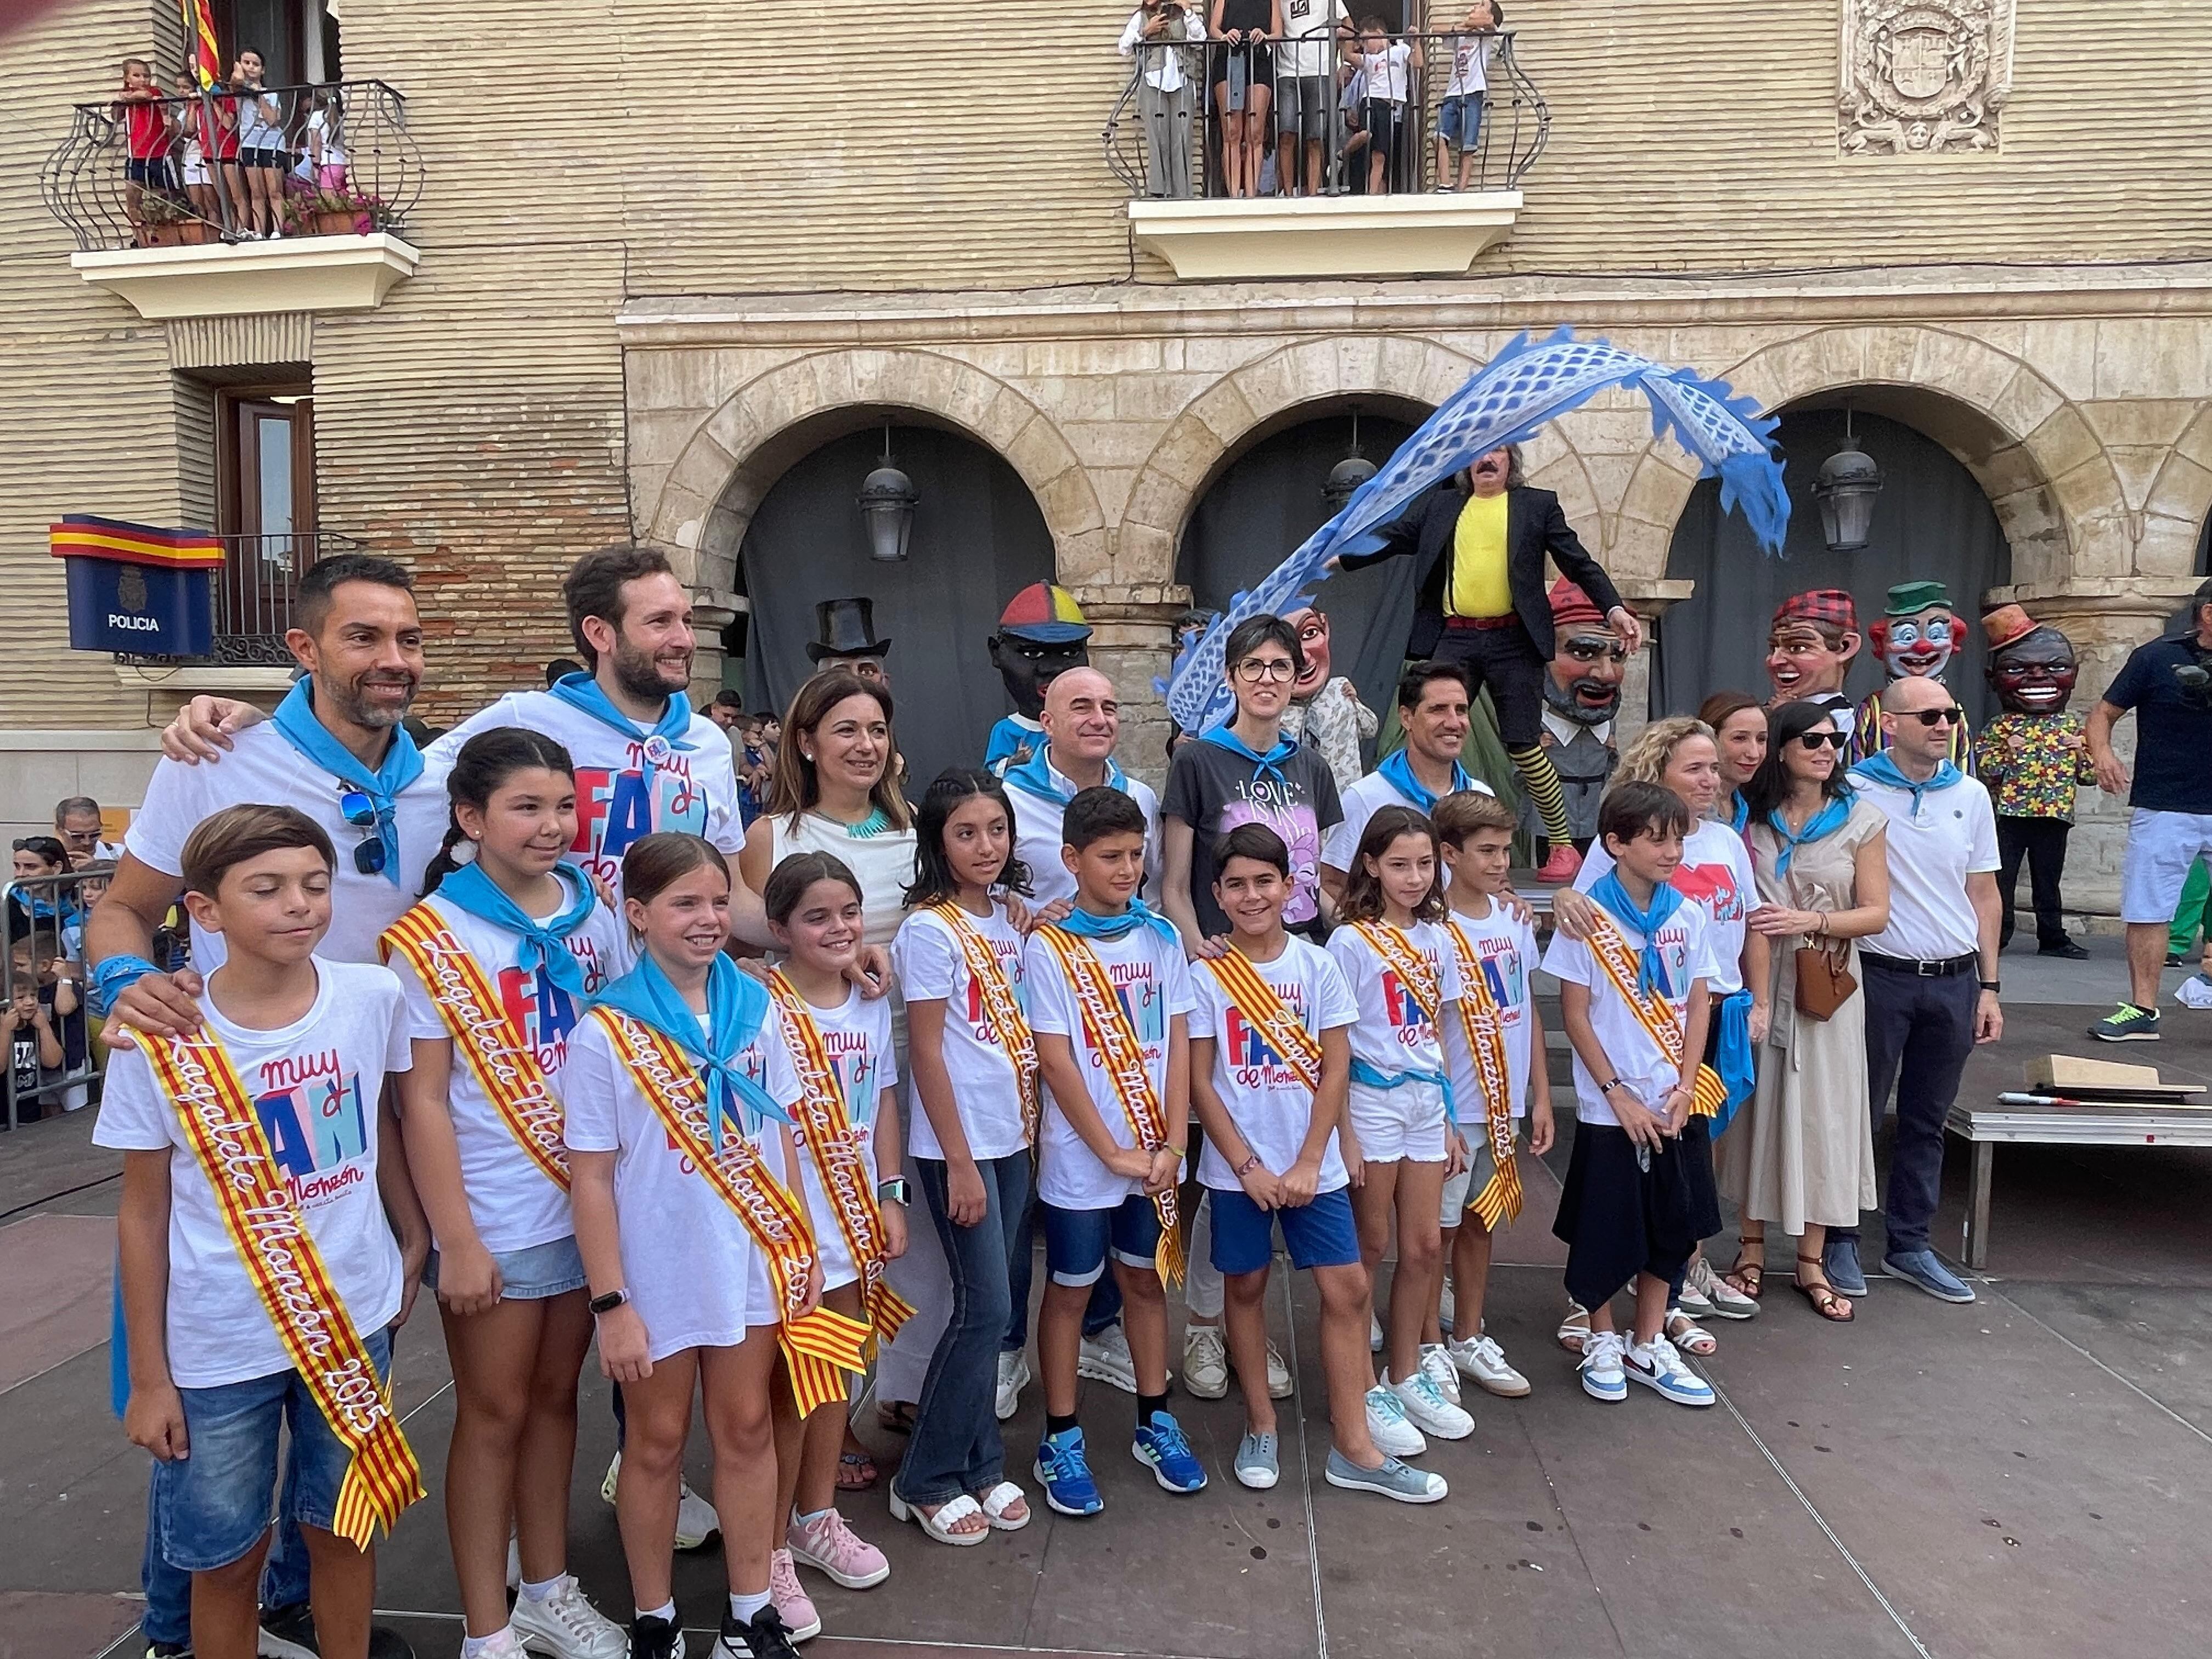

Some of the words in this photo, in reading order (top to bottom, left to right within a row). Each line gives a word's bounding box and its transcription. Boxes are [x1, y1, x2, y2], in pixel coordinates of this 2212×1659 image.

[109, 614, 159, 631] POLICIA
[1239, 780, 1298, 806] LOVE
[1249, 799, 1269, 822] IS
[1273, 804, 1298, 827] IN
[1479, 936, 1518, 975] muy
[1480, 952, 1523, 1009] AN
[420, 930, 535, 1086] Zagaleta
[1109, 962, 1156, 1008] muy
[975, 1007, 1000, 1045] de
[1398, 1014, 1418, 1047] de
[260, 1048, 351, 1118] muy
[822, 1031, 871, 1084] muy
[1237, 1051, 1261, 1088] de
[1470, 1006, 1503, 1107] Monzón
[1494, 1112, 1515, 1159] 2025
[1063, 945, 1127, 1060] Zagalete
[1159, 1188, 1178, 1227] 025
[253, 1070, 368, 1177] AN
[285, 1164, 364, 1205] Monzón
[822, 1129, 870, 1250] Monzón
[166, 1024, 266, 1194] Zagalete
[244, 1189, 330, 1358] Monzón
[325, 1358, 393, 1434] 2025
[708, 1133, 792, 1245] Monzón
[783, 1254, 812, 1322] 202
